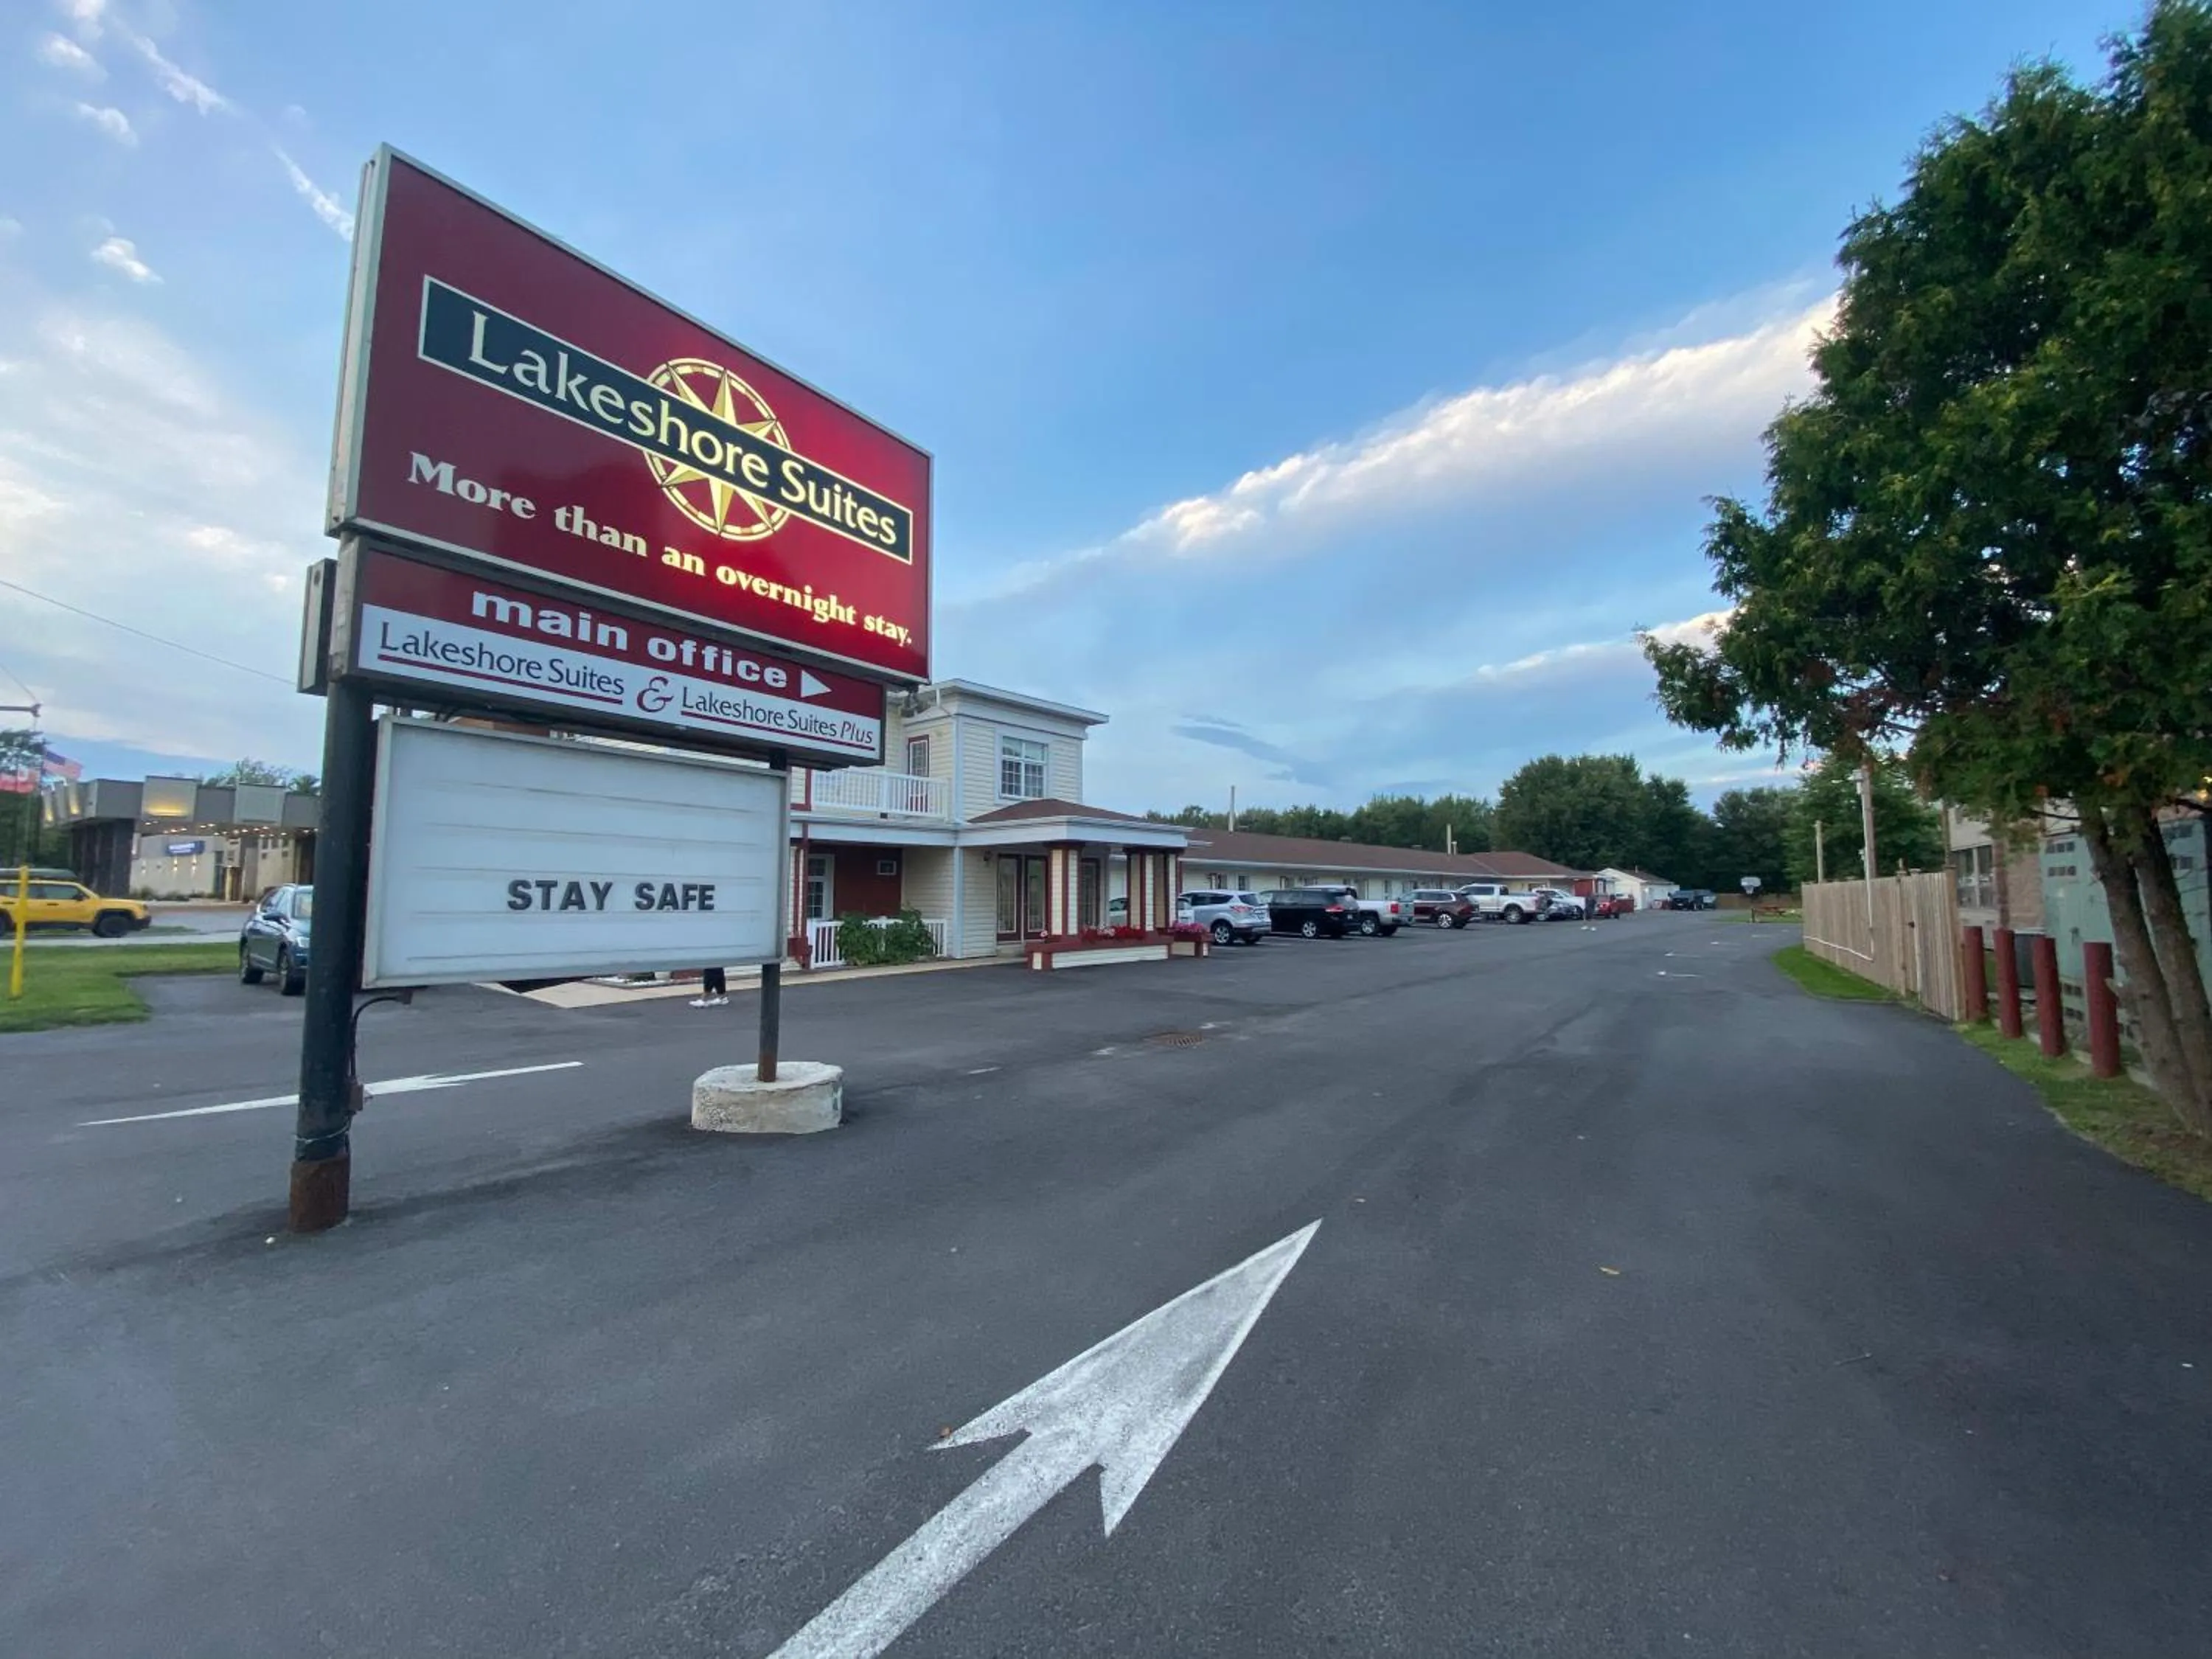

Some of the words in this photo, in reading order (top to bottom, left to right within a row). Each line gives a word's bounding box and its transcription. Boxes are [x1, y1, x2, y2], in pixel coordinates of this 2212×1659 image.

[469, 311, 770, 488] Lakeshore
[780, 459, 897, 545] Suites
[409, 451, 537, 520] More
[554, 505, 648, 557] than
[661, 545, 706, 578] an
[716, 563, 856, 625] overnight
[863, 611, 911, 646] stay.
[380, 621, 542, 679] Lakeshore
[548, 658, 625, 695] Suites
[637, 676, 673, 713] &
[682, 686, 784, 725] Lakeshore
[787, 709, 837, 737] Suites
[840, 720, 873, 744] Plus
[472, 590, 627, 650] main
[647, 636, 787, 688] office
[507, 880, 613, 911] STAY
[634, 883, 715, 911] SAFE
